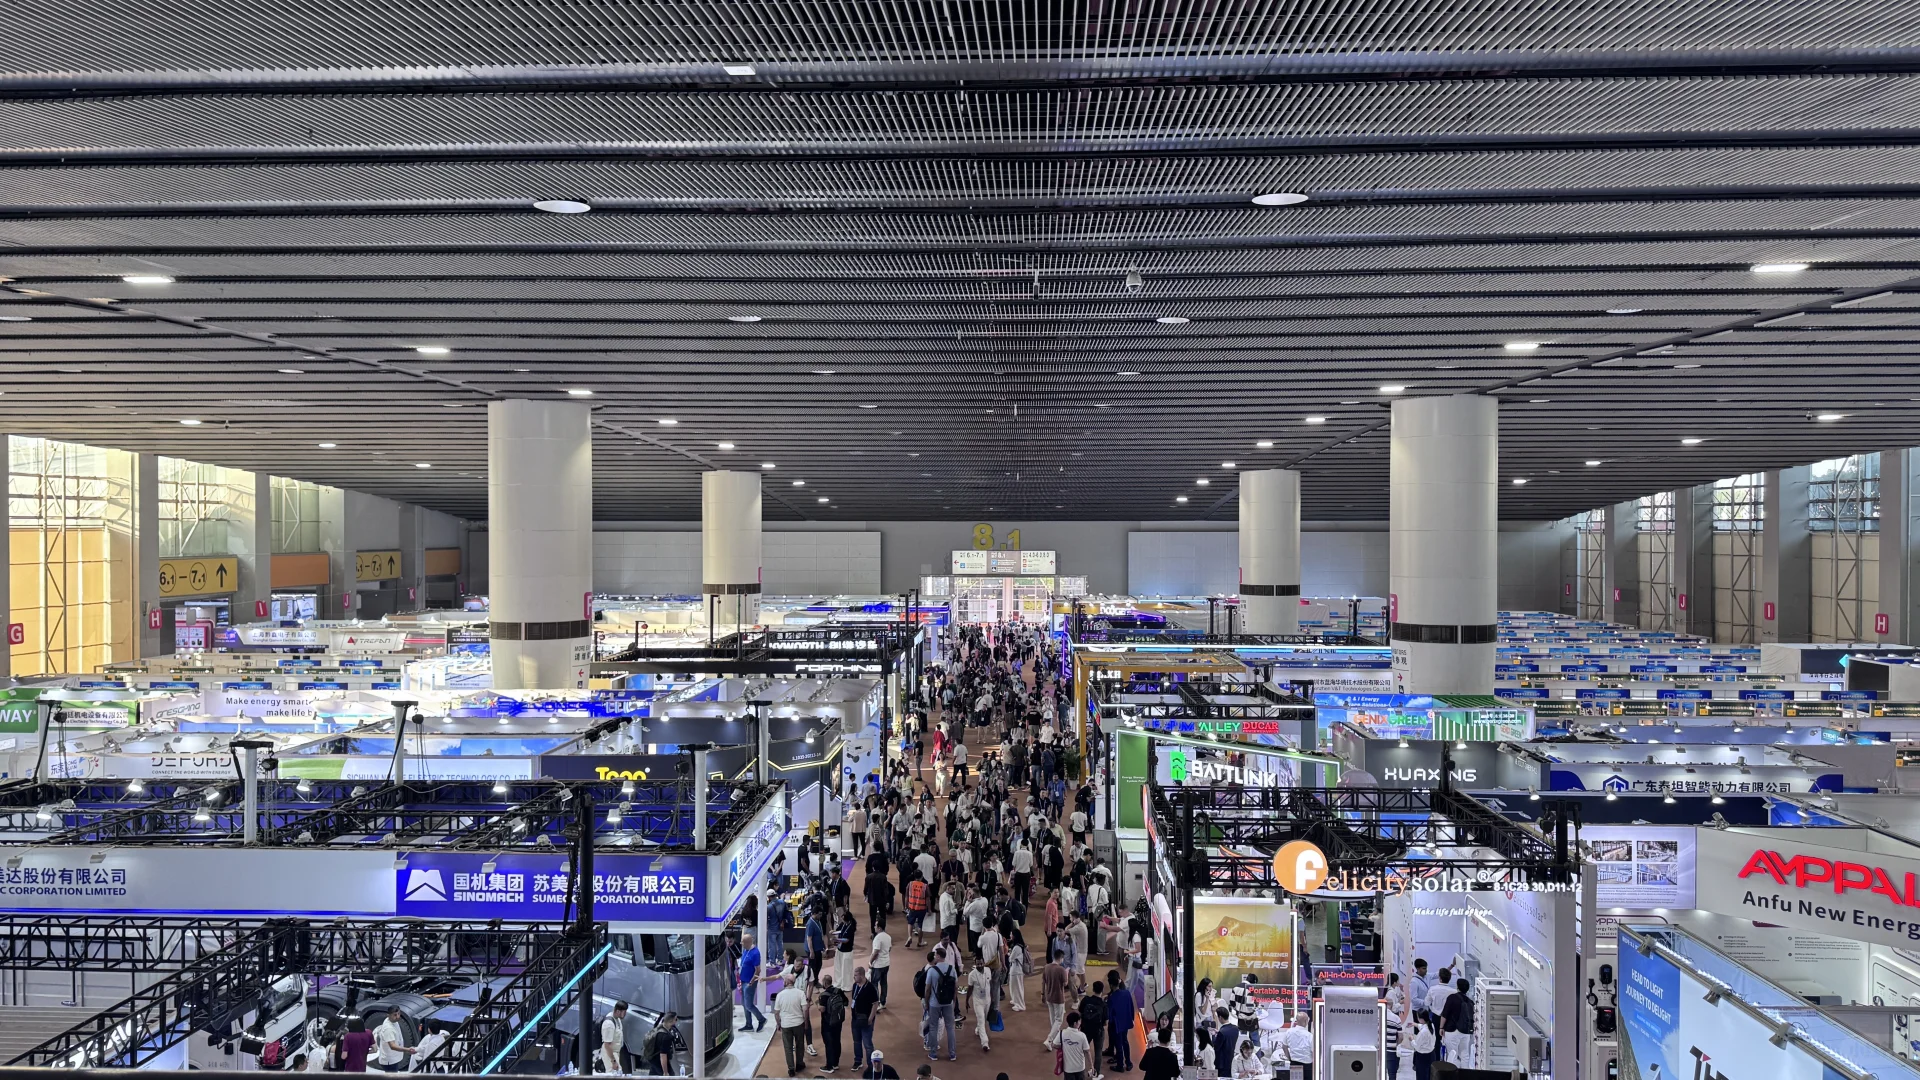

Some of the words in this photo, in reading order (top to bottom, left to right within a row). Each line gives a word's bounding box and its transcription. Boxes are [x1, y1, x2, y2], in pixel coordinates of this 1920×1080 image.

[973, 523, 1020, 550] 8.1
[795, 664, 882, 672] FORTHING
[226, 697, 249, 705] Make
[250, 697, 281, 707] energy
[266, 709, 288, 717] make
[291, 709, 305, 717] life
[1242, 722, 1279, 730] DUCAR
[1191, 760, 1277, 788] BATTLINK
[1385, 767, 1477, 782] HUAXNG
[453, 873, 524, 891] 国机集团
[9, 887, 83, 896] CORPORATION
[85, 887, 126, 896] LIMITED
[453, 891, 524, 903] SINOMACH
[652, 895, 695, 904] LIMITED
[1743, 890, 1792, 912] Anfu
[1799, 899, 1846, 922] New
[1245, 961, 1289, 969] YEARS
[1318, 971, 1355, 980] All-in-One
[1357, 971, 1385, 980] System
[1631, 969, 1643, 985] HEAD
[1649, 981, 1664, 1000] LIGHT
[1249, 986, 1280, 995] Portable
[1625, 984, 1645, 1007] JOURNEY
[1651, 1002, 1672, 1025] DELIGHT
